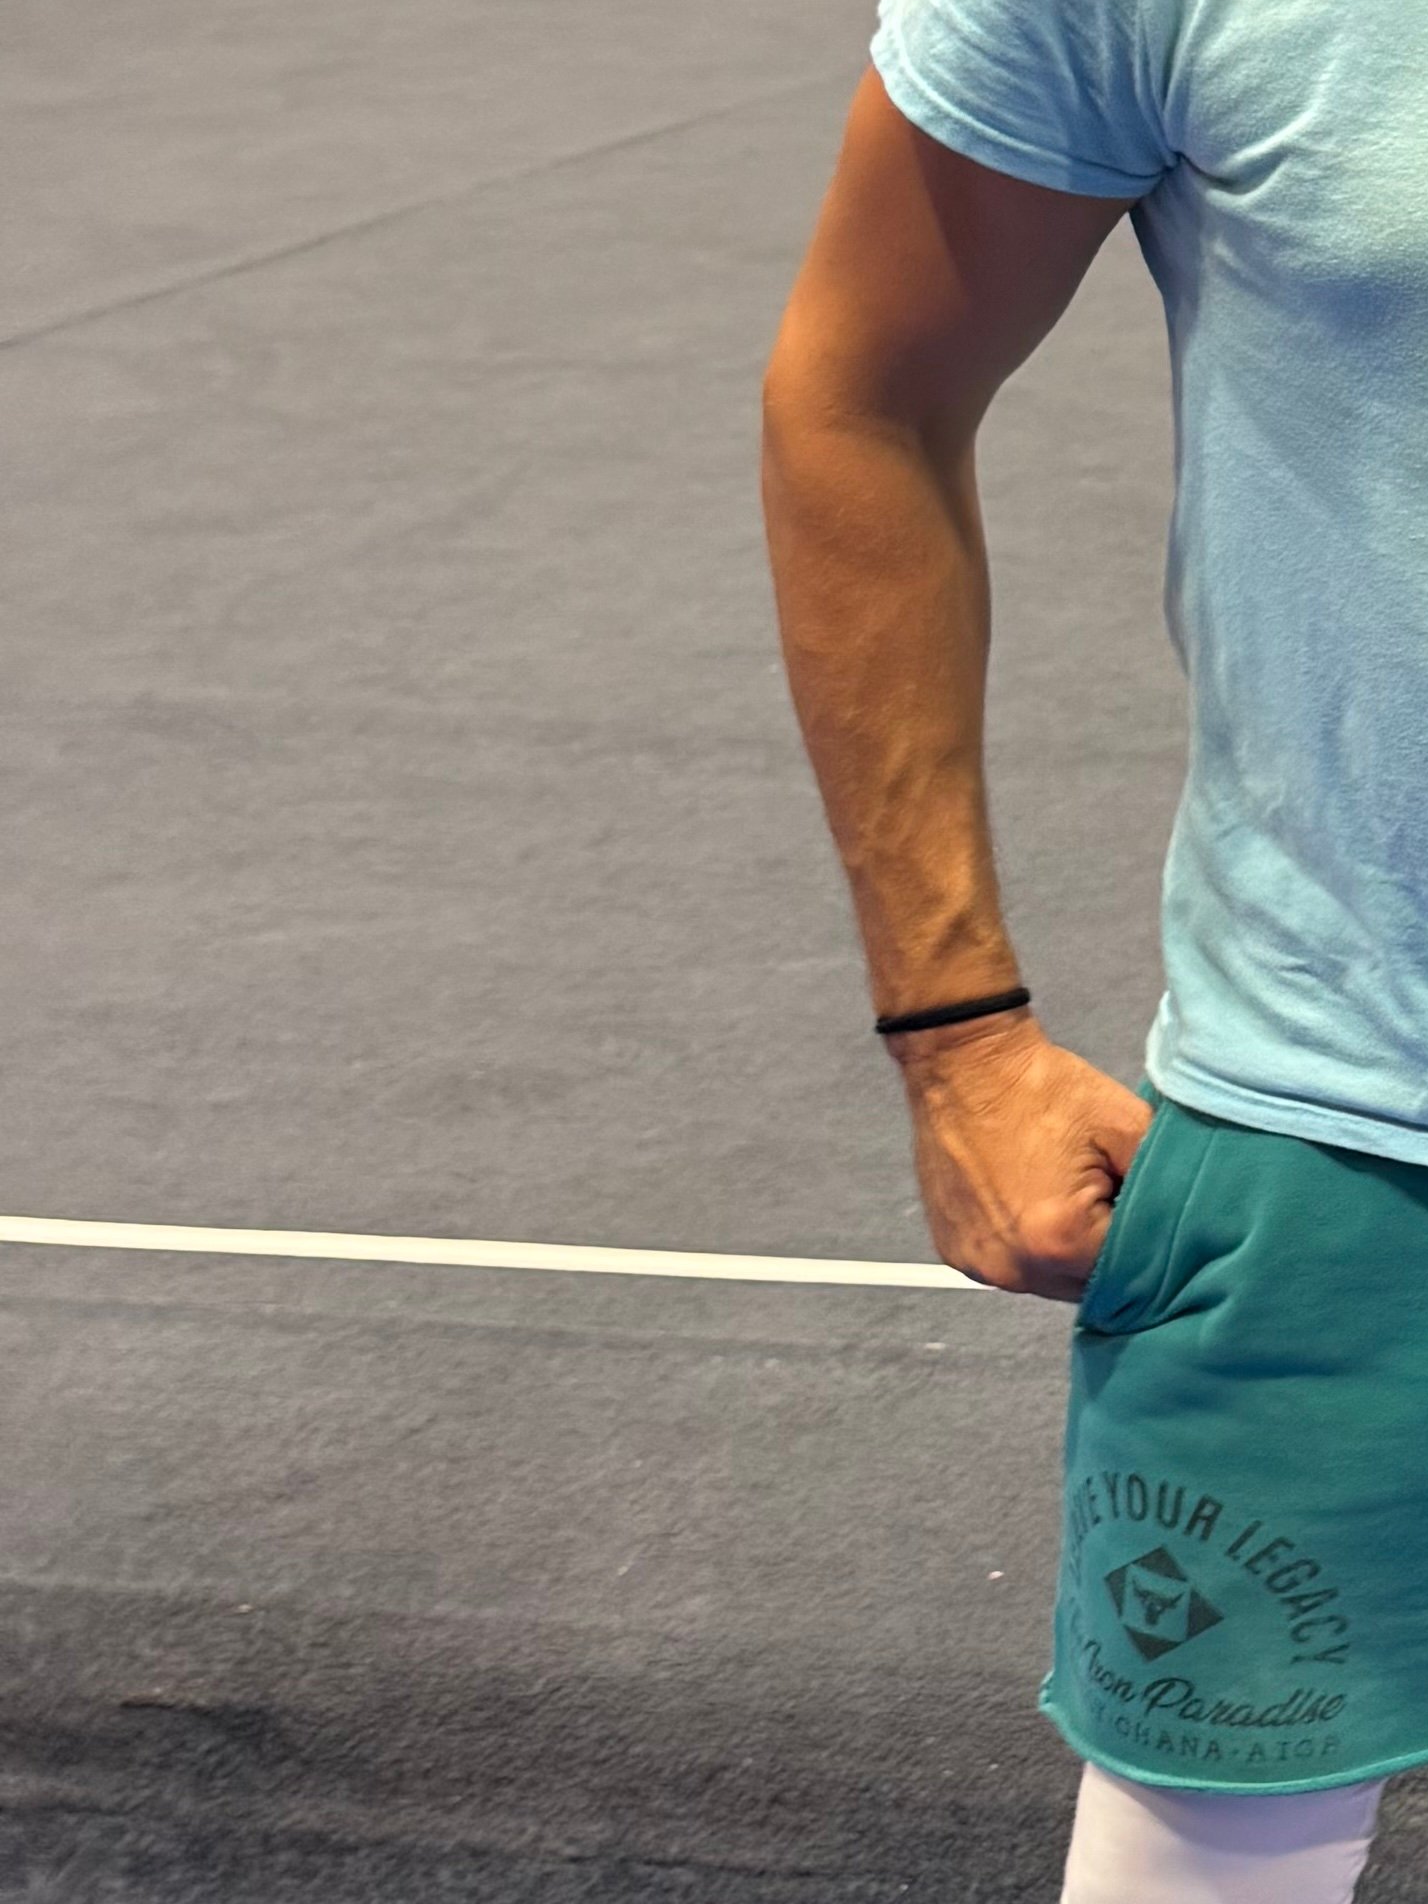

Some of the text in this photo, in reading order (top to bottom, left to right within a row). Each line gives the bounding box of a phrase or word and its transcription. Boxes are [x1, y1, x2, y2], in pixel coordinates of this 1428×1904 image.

[1103, 1470, 1225, 1543] YOUR
[1224, 1518, 1354, 1666] LEGACY
[1136, 1676, 1349, 1729] Paradise
